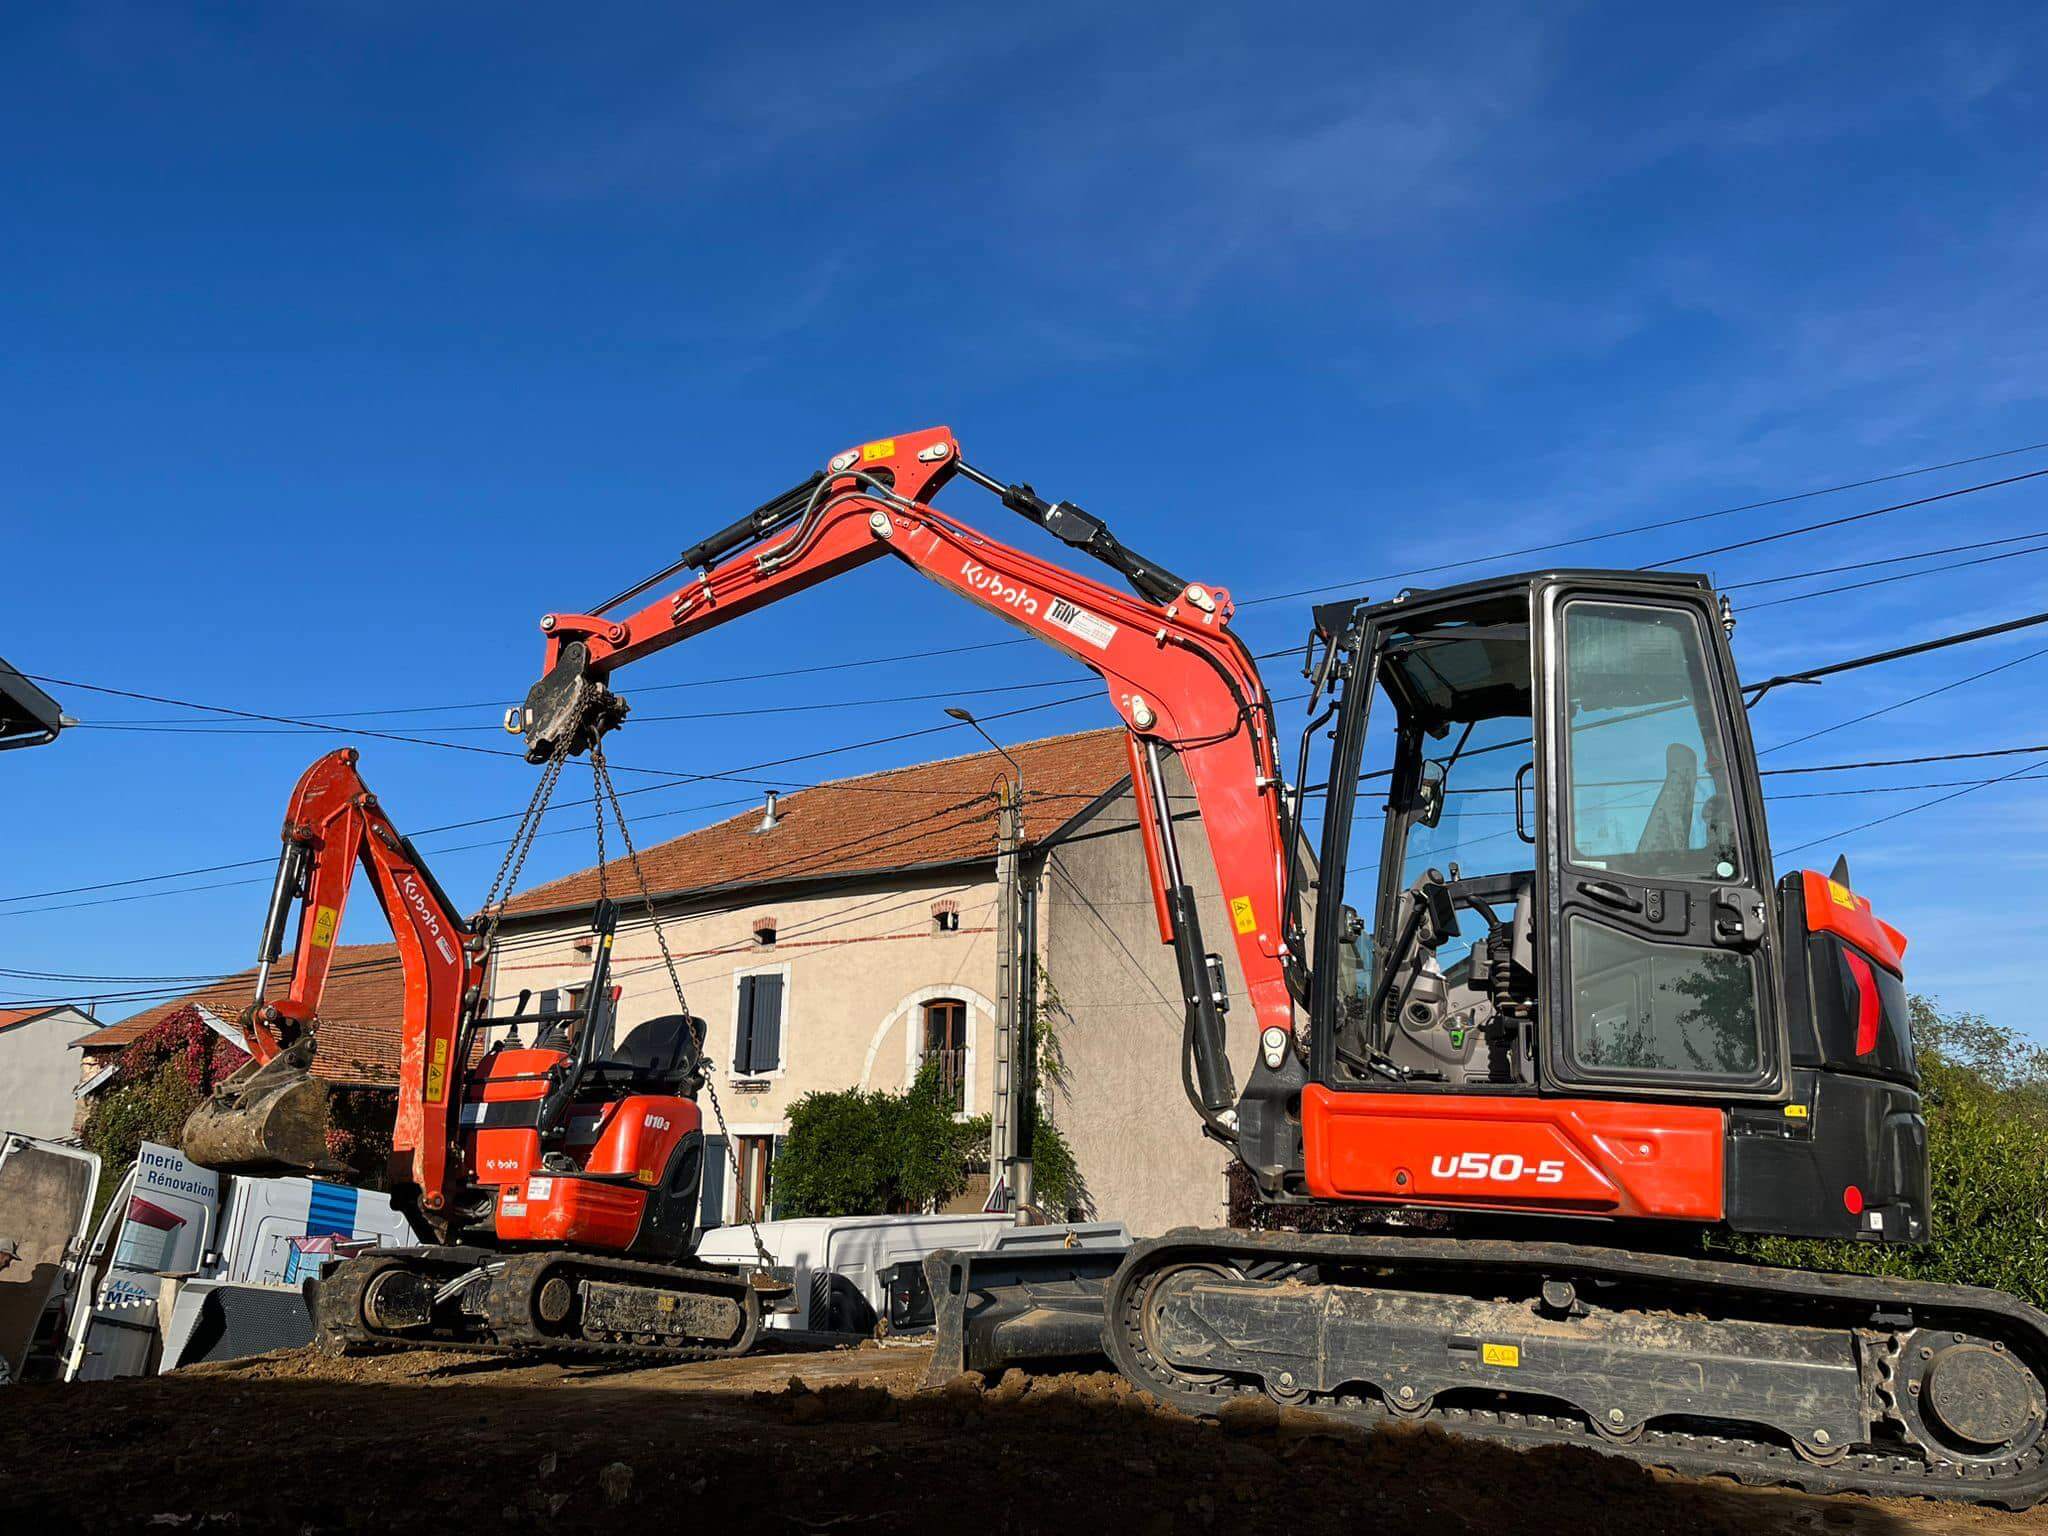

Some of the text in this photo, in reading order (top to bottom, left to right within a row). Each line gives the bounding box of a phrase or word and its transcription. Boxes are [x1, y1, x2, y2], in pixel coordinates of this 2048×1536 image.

[961, 559, 1039, 616] Kubota
[403, 875, 440, 937] Kubota
[147, 1170, 215, 1198] Rénovation
[1431, 1152, 1565, 1183] U50-5
